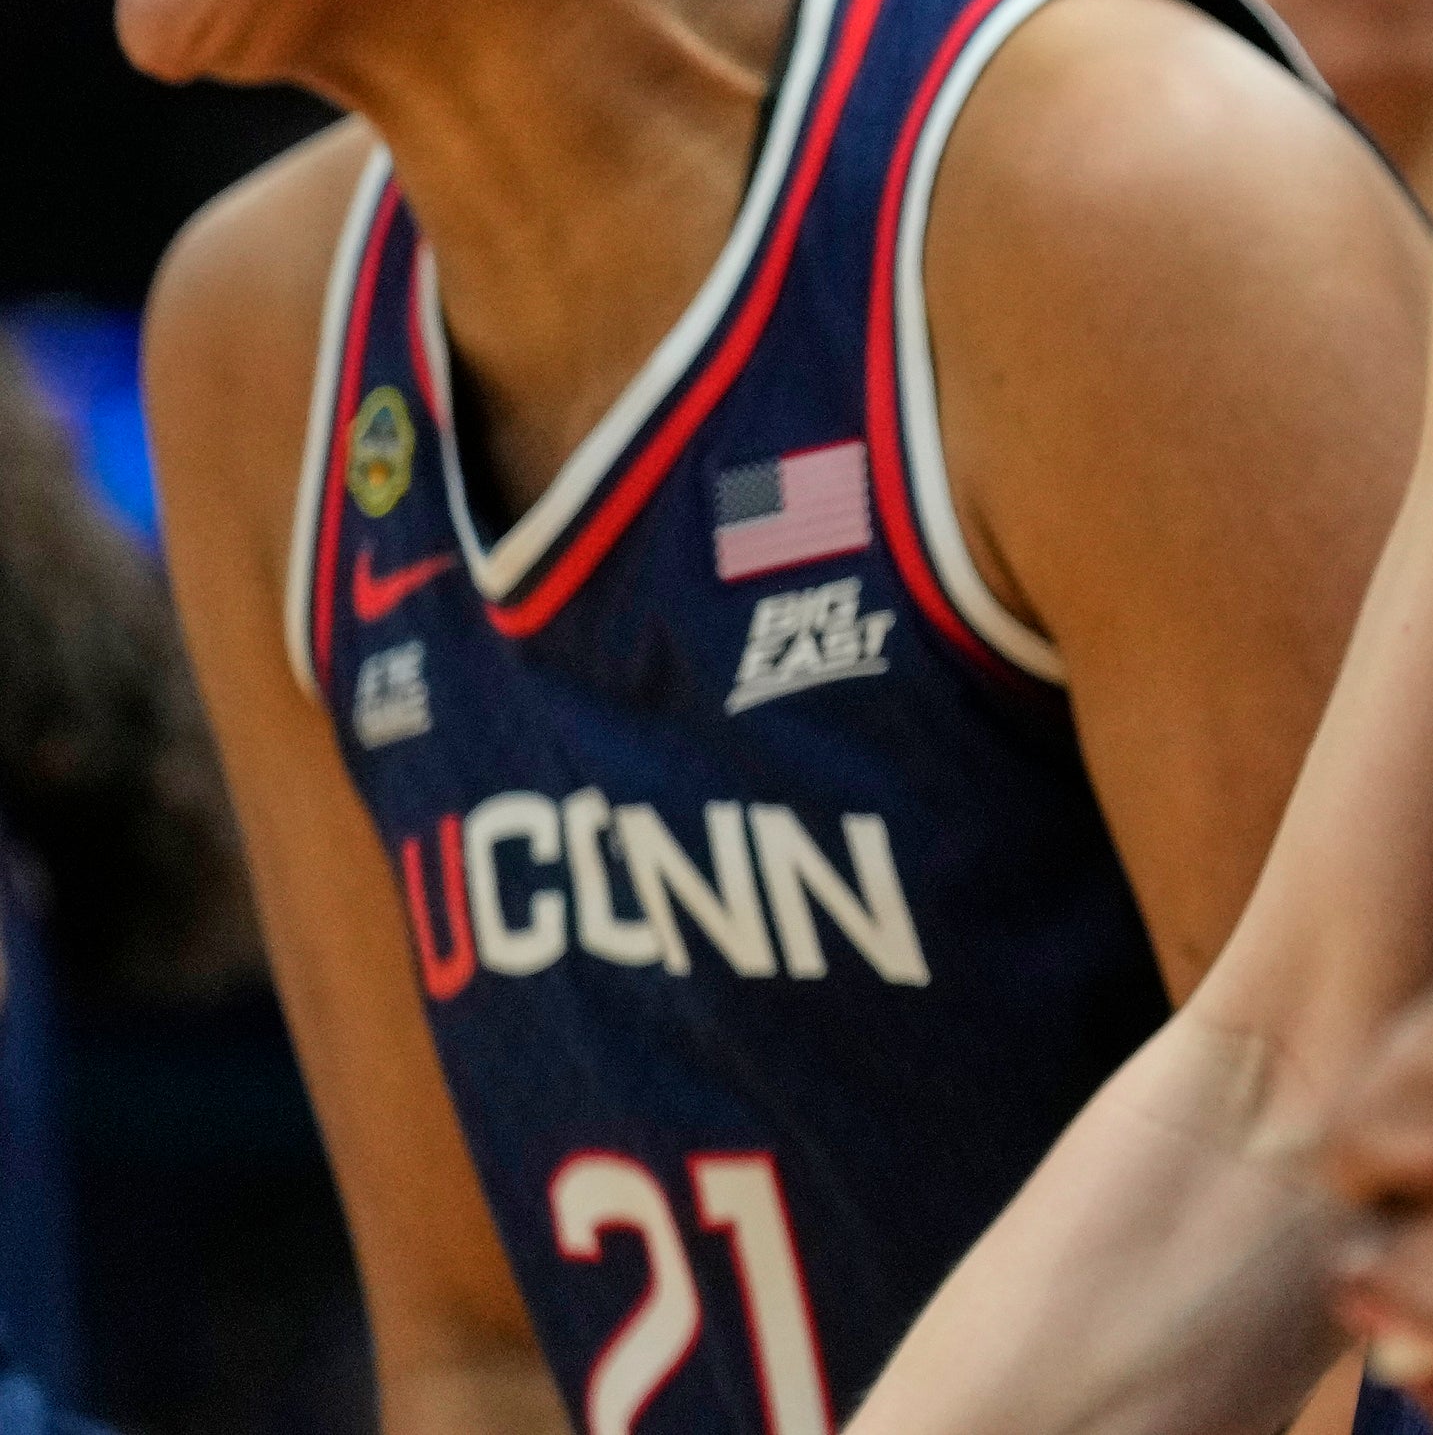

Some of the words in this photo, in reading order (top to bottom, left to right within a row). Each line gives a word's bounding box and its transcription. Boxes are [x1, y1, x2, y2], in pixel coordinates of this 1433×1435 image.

[735, 610, 896, 685] EAST
[752, 576, 863, 642] BIG
[403, 787, 932, 1001] UCONN
[547, 1147, 838, 1435] 21
